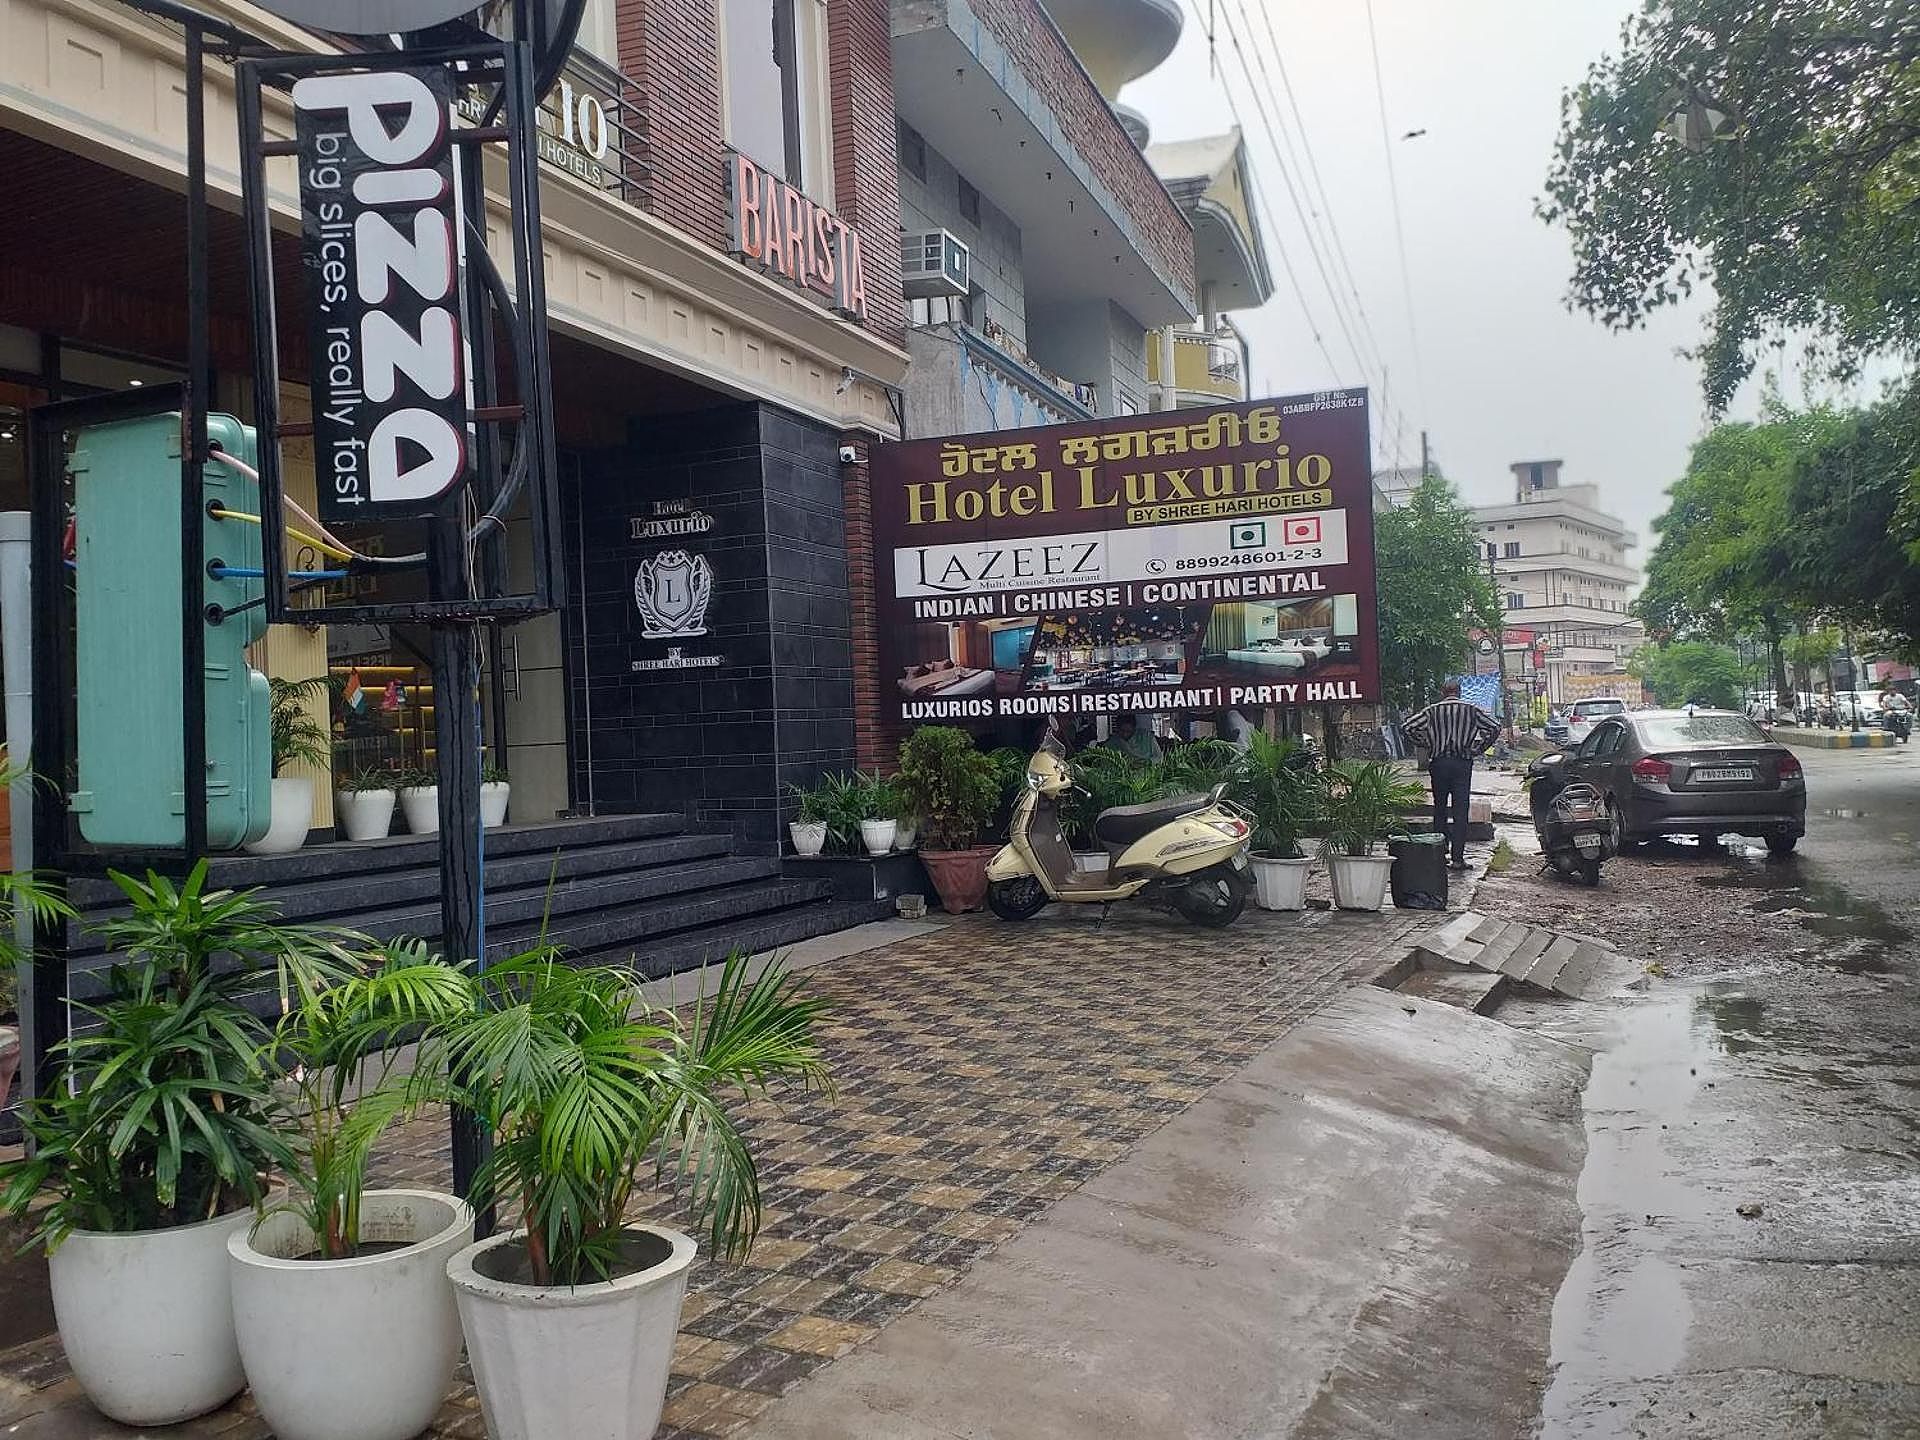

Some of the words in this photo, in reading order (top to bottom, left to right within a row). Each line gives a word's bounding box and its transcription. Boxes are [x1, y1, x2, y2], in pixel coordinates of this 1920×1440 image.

[309, 132, 348, 189] big
[546, 141, 602, 184] HOTELS
[319, 203, 354, 313] slices,
[737, 154, 868, 320] BARISTA
[323, 327, 362, 426] really
[332, 437, 366, 506] fast
[940, 441, 1038, 477] ਹੋਟਲ
[903, 470, 1058, 525] Hotel
[1074, 444, 1332, 510] Luxurio
[1133, 508, 1156, 522] BY
[1158, 503, 1210, 519] SHREE
[1215, 498, 1252, 514] HARI
[1258, 492, 1322, 509] HOTELS
[630, 511, 713, 539] Luxurio
[917, 542, 1101, 592] LAZEEZ
[1048, 574, 1101, 585] Restaurant
[1175, 548, 1323, 570] 8899248601-2-3
[664, 578, 681, 604] L
[914, 595, 994, 618] INDIAN
[1014, 587, 1121, 613] CHINESE
[1142, 571, 1327, 604] CONTINENTAL
[901, 699, 993, 719] LUXURIOS
[1000, 695, 1070, 716] ROOMS
[1082, 688, 1213, 712] RESTAURANT
[1230, 684, 1298, 705] PARTY
[1306, 681, 1363, 701] HALL
